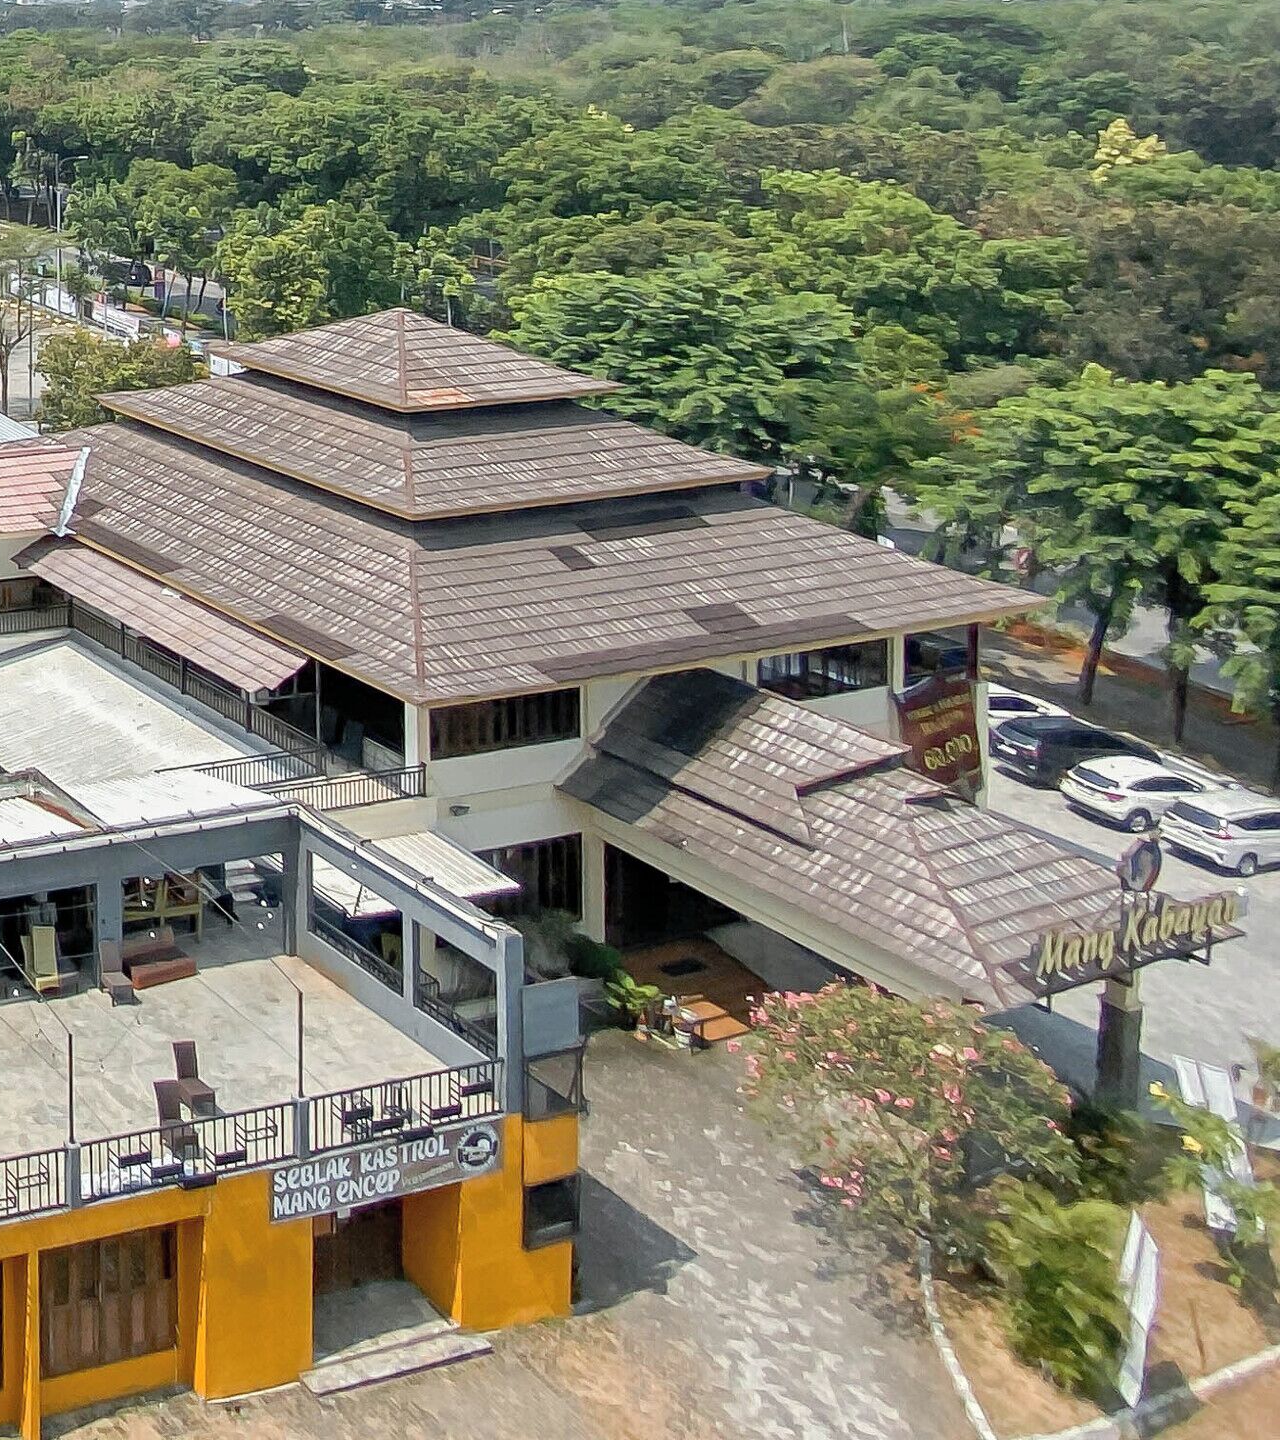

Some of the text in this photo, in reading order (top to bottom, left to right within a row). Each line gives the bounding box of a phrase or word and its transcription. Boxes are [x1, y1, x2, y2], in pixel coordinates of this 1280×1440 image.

[1035, 892, 1239, 979] Mang Kabayan
[272, 1157, 353, 1193] SEBLAK
[359, 1133, 451, 1172] KASTROL
[273, 1184, 332, 1218] MANG
